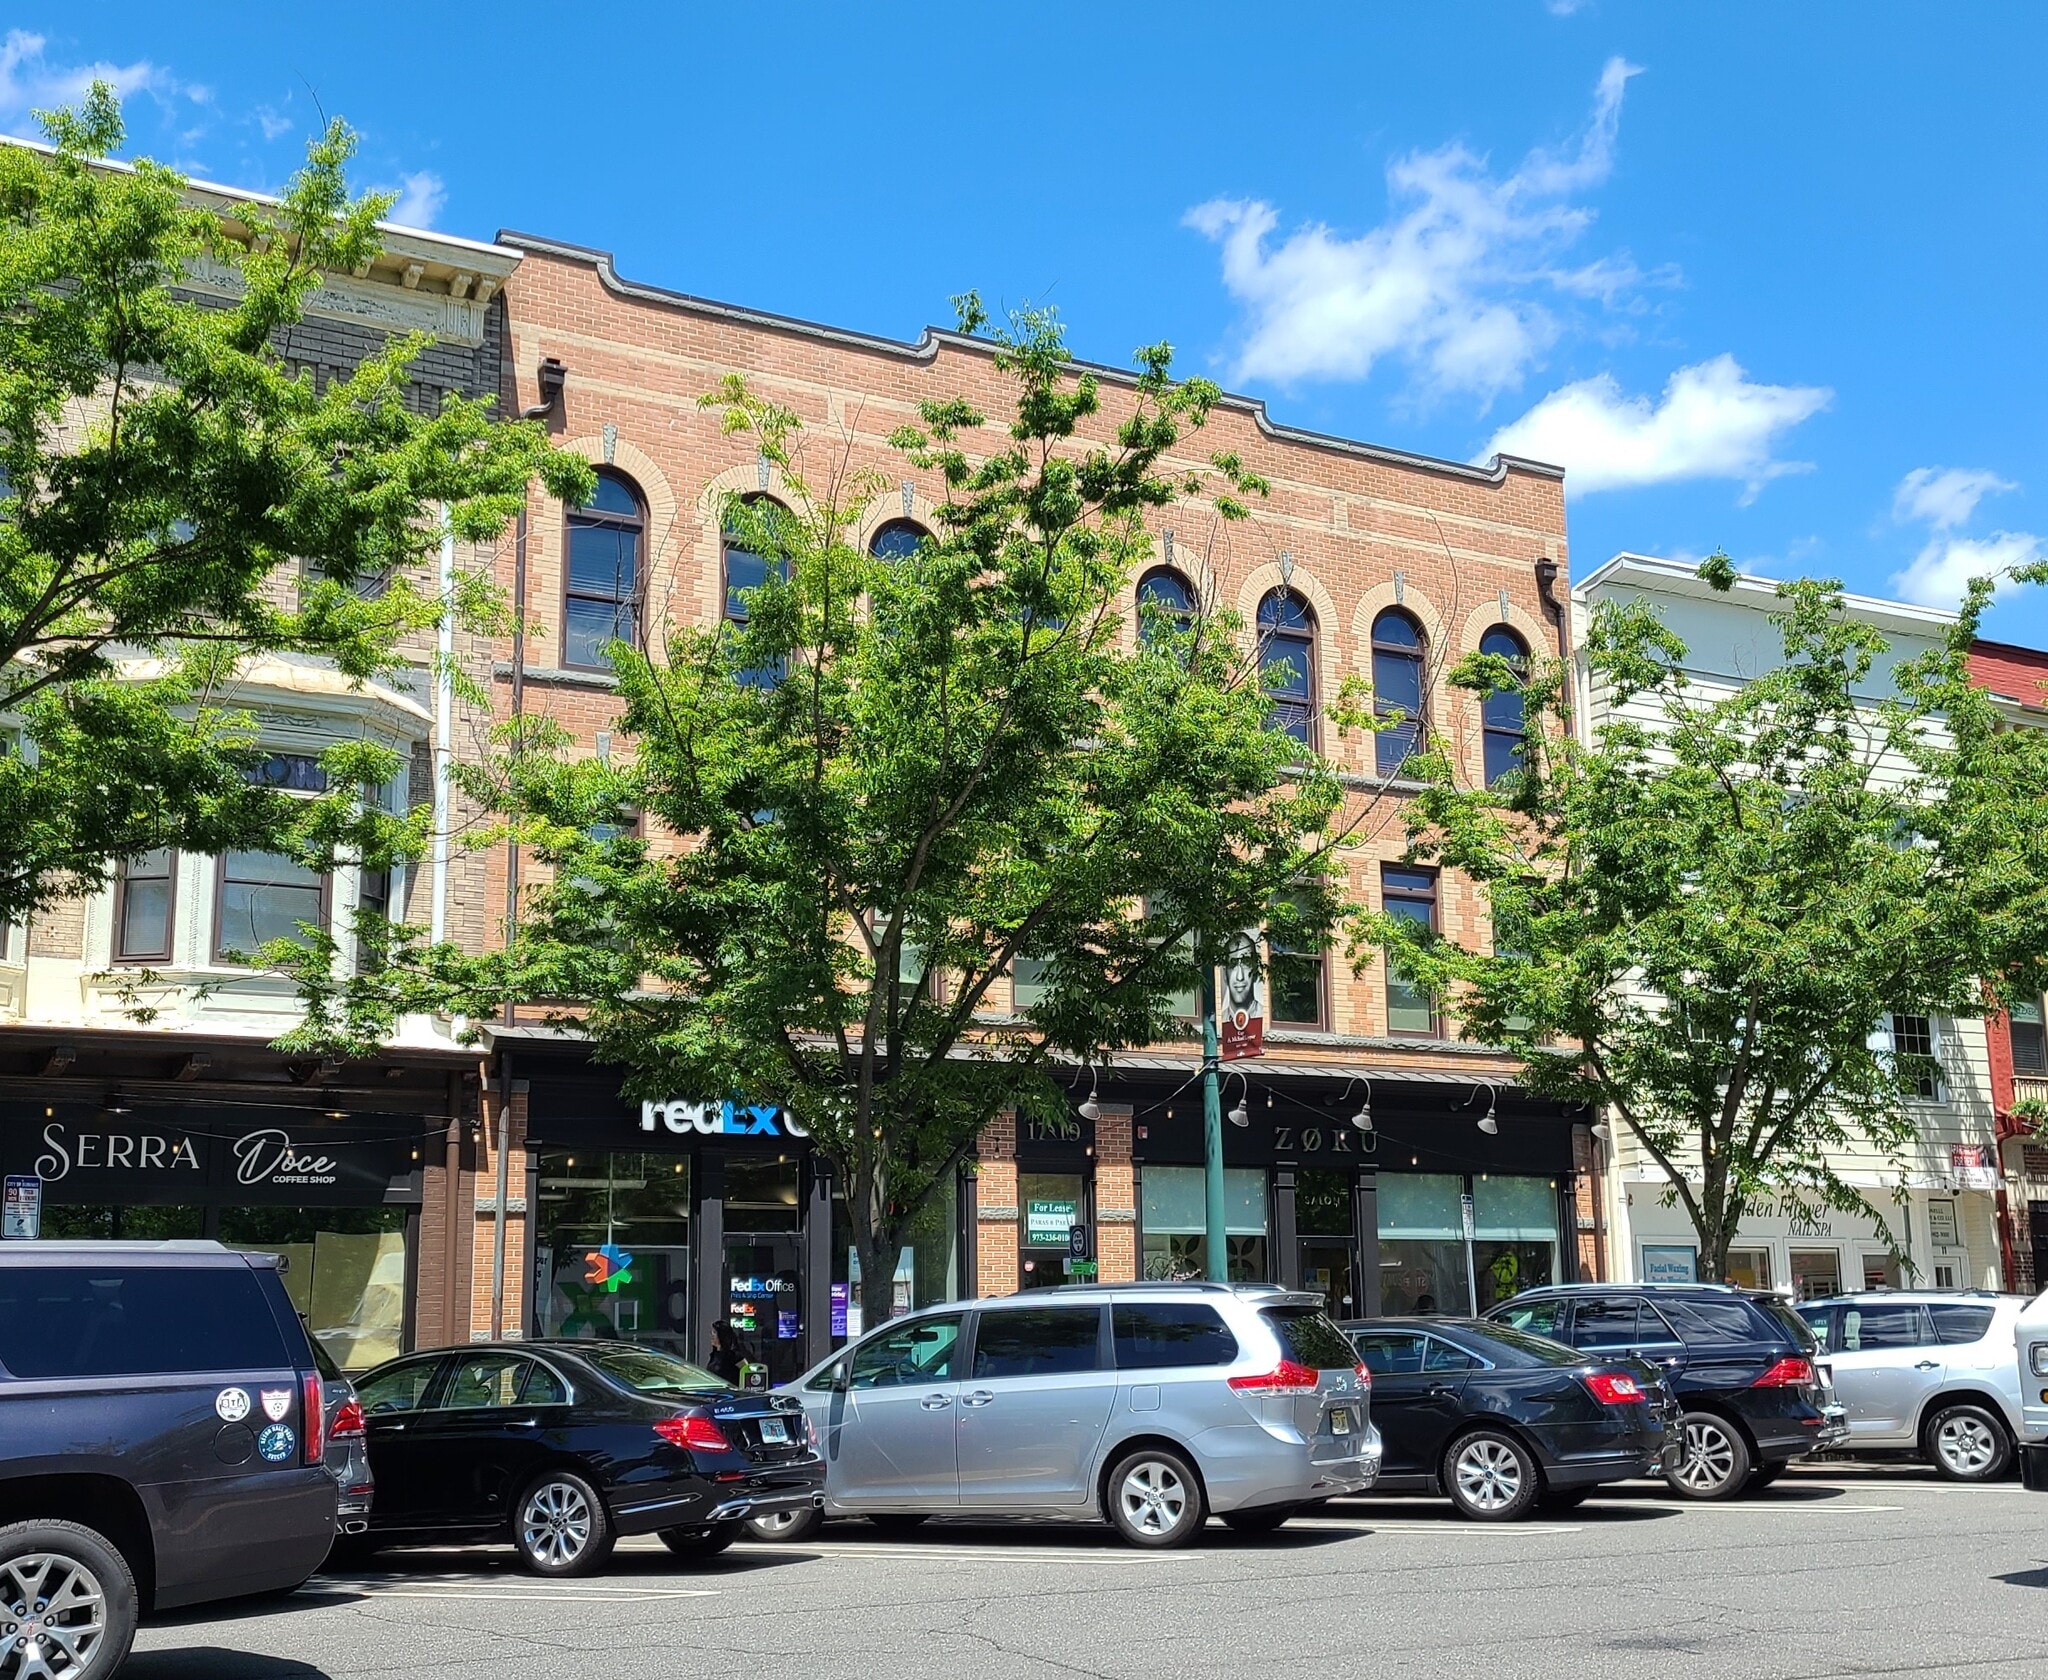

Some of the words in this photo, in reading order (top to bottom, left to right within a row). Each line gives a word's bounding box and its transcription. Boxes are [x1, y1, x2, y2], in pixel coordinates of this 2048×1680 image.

[34, 1123, 200, 1182] SERRA
[233, 1129, 337, 1184] Doce
[272, 1175, 308, 1183] COFFEE
[309, 1176, 336, 1184] SHOP
[1034, 1203, 1047, 1212] For
[1049, 1203, 1069, 1212] Lease
[1787, 1221, 1812, 1236] NAIL
[1814, 1222, 1832, 1237] SPA
[731, 1276, 765, 1292] FedEx
[766, 1279, 794, 1292] Office
[731, 1303, 754, 1313] FedEx
[731, 1318, 754, 1328] FedEx
